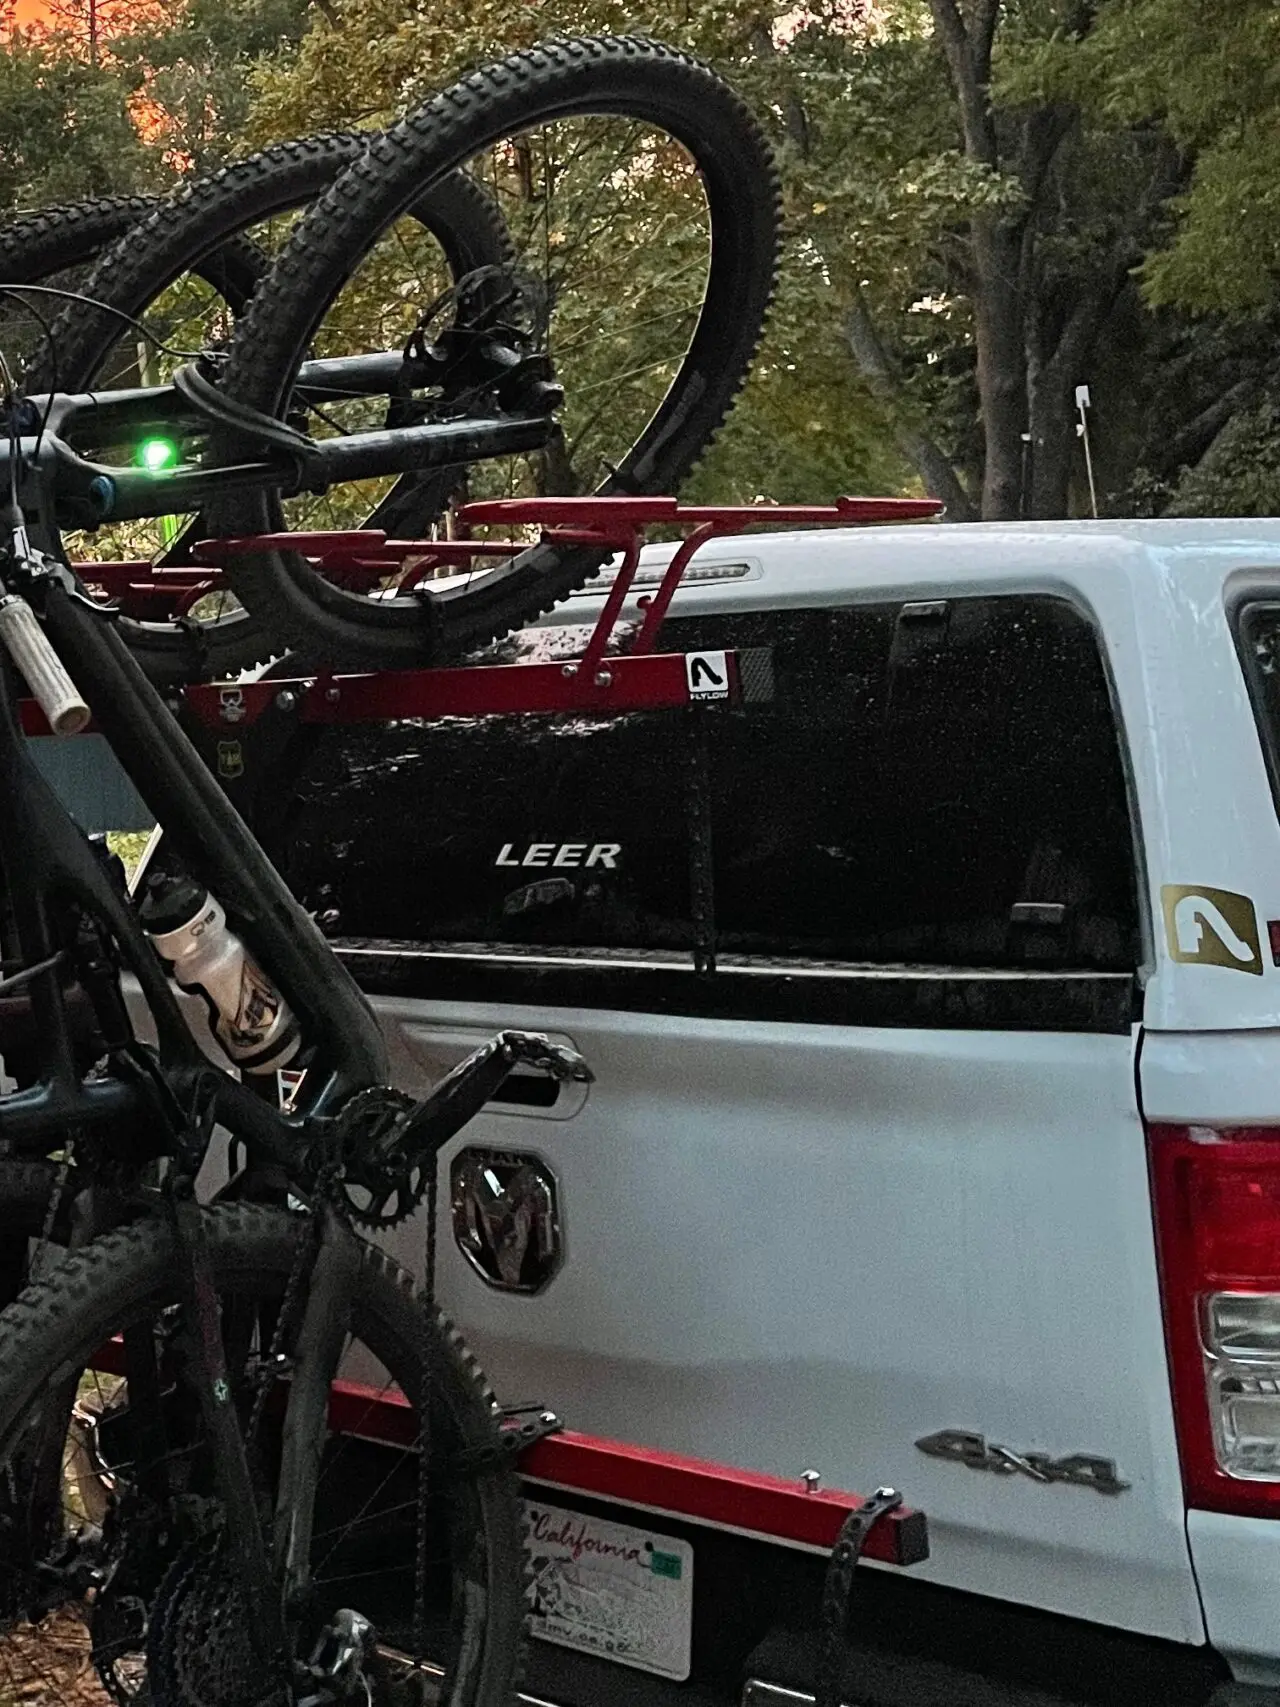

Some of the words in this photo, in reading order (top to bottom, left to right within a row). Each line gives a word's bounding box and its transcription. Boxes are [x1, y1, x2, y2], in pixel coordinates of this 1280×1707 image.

[689, 690, 729, 701] FLYLOW
[494, 842, 622, 869] LEER
[532, 1513, 651, 1567] California
